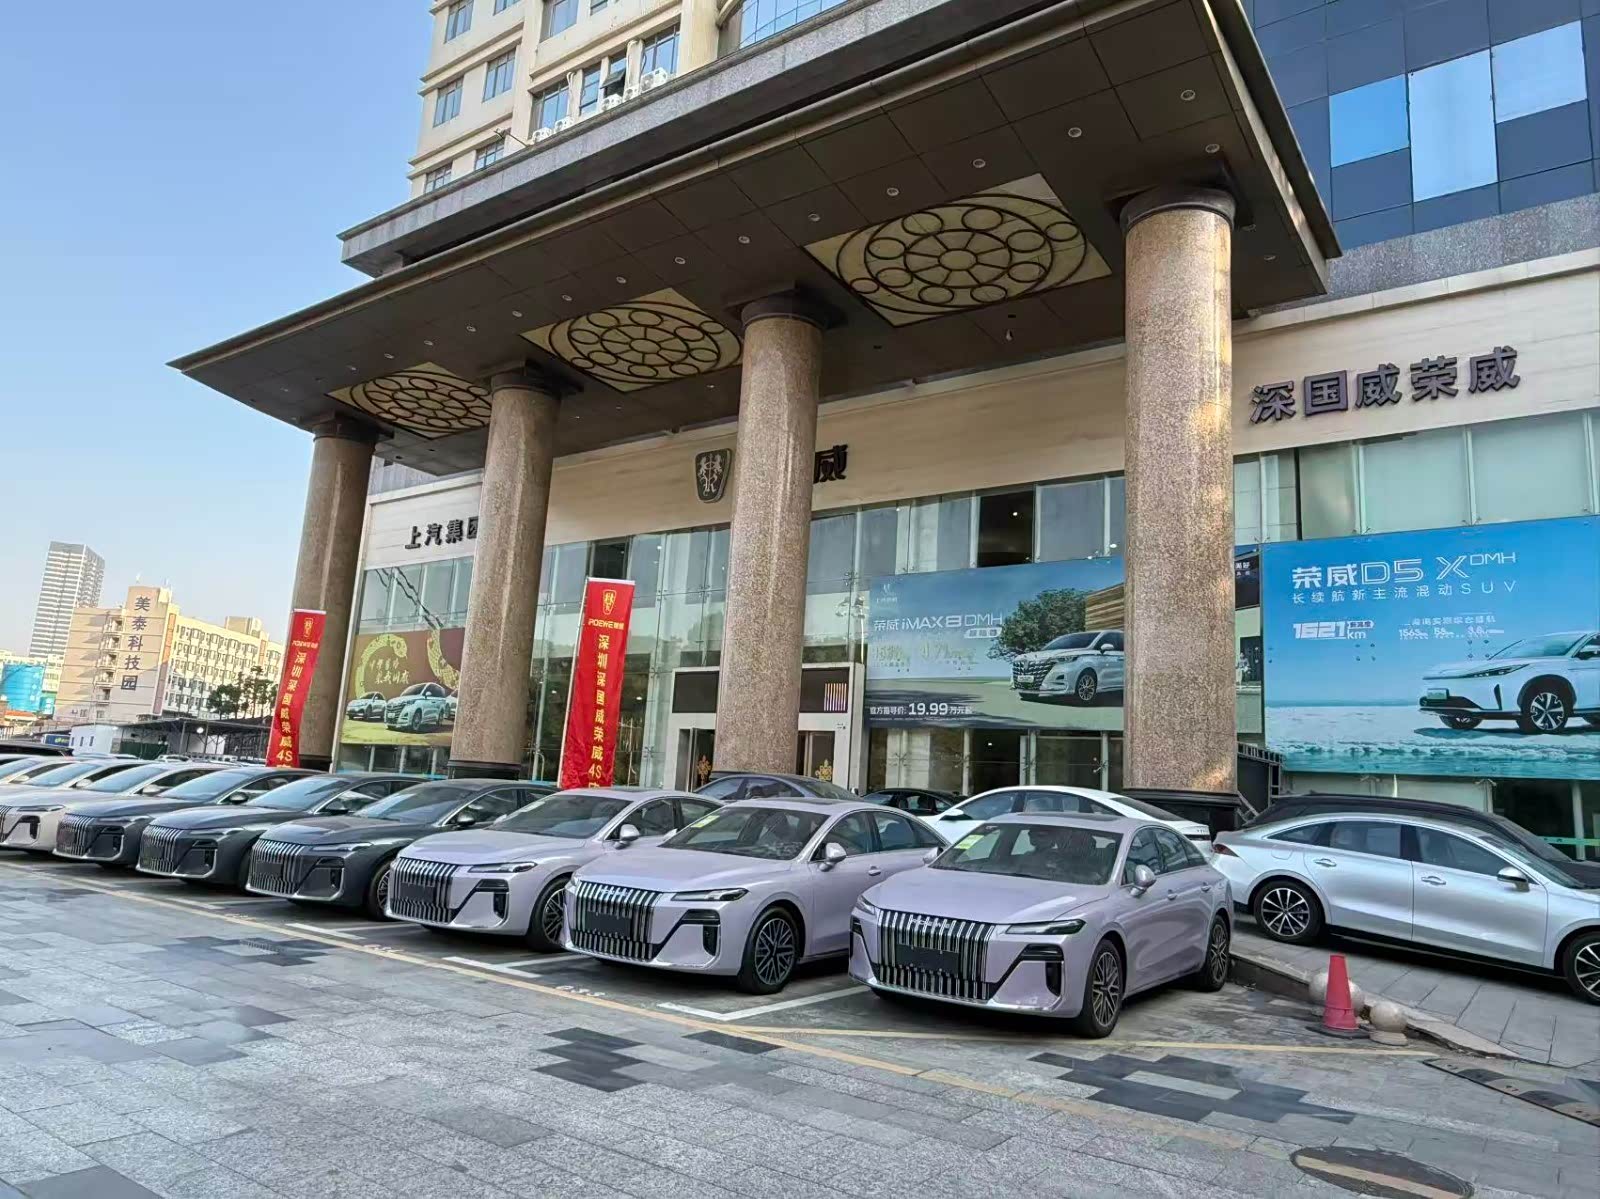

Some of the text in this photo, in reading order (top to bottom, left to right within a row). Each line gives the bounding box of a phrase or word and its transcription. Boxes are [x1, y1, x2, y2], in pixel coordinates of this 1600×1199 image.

[1250, 346, 1521, 423] 深国威荣威
[813, 444, 848, 484] 威
[404, 515, 479, 550] 上汽集团
[120, 596, 151, 690] 美泰科技园
[276, 651, 307, 768] 深圳深国威荣威4S
